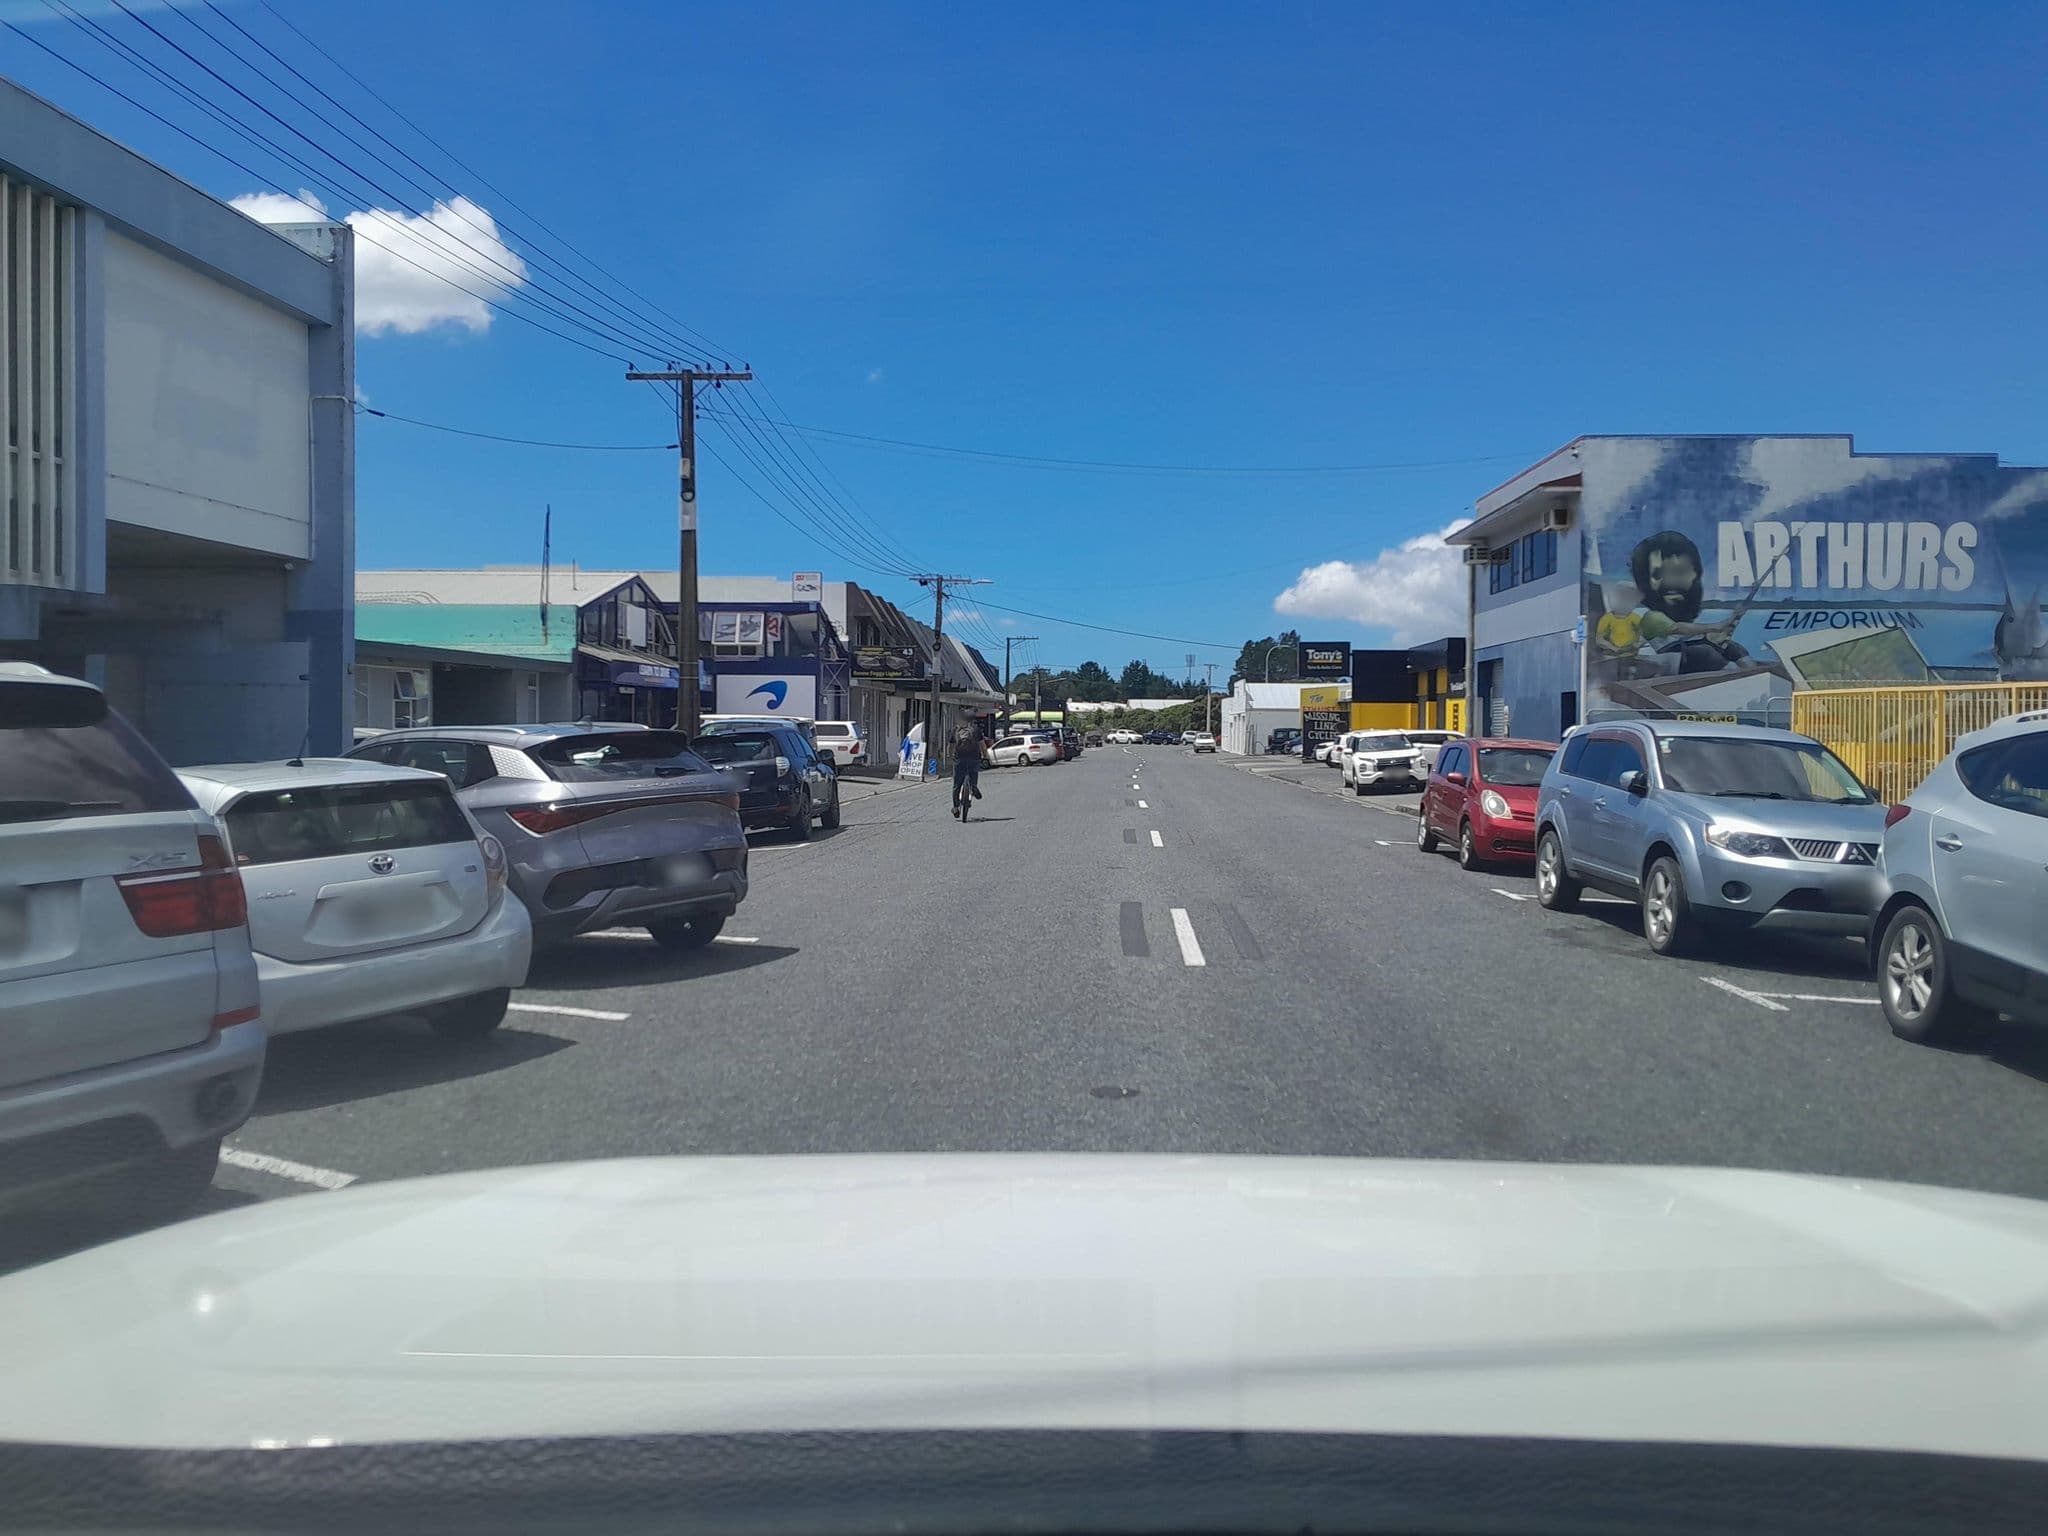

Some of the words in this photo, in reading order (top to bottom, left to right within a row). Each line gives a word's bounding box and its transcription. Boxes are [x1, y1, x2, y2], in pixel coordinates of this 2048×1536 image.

[1718, 520, 1978, 592] ARTHURS
[1764, 610, 1925, 631] EMPORIUM
[902, 648, 914, 656] 43
[1306, 649, 1342, 662] Tony's
[1679, 715, 1735, 723] PARKING
[1314, 721, 1338, 730] LINK
